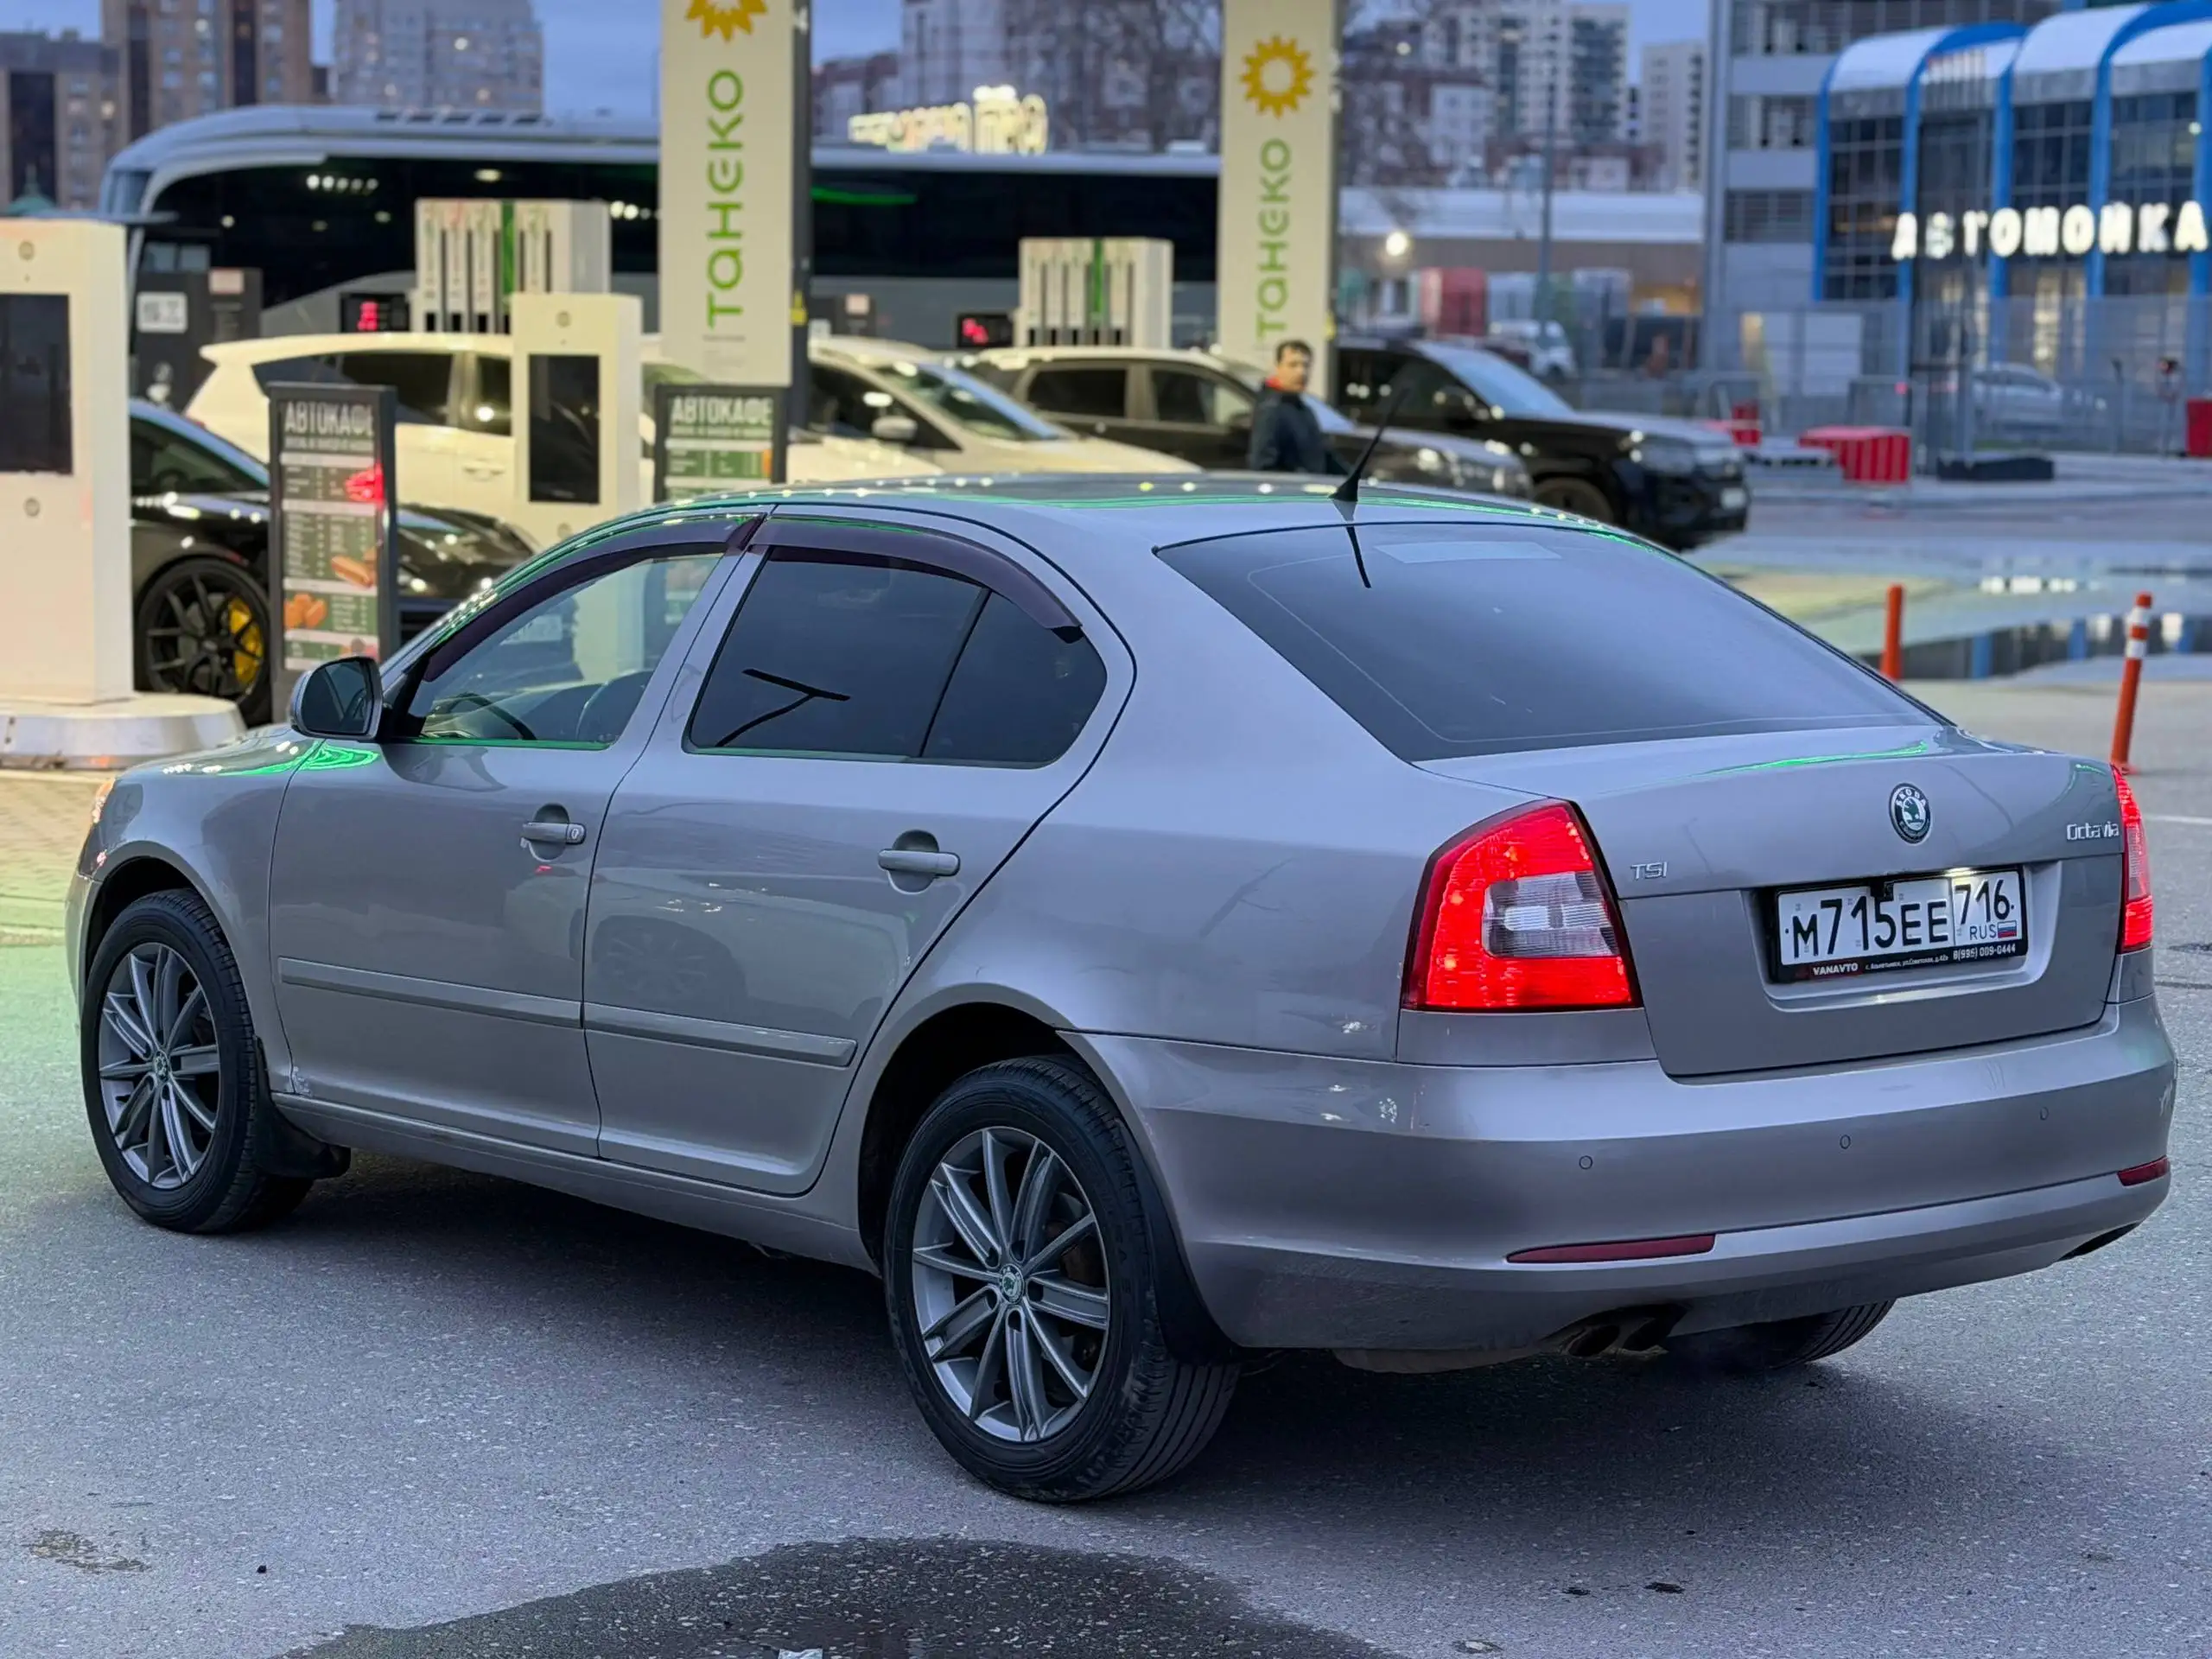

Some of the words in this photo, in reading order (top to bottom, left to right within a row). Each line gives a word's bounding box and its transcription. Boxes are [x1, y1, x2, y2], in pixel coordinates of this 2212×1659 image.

[671, 397, 772, 426] АВТОКАФЕ
[2067, 821, 2120, 840] Octavia
[1631, 861, 1668, 880] TSI
[1955, 880, 2011, 925] 716
[1969, 924, 1997, 941] RUS
[1813, 963, 1859, 975] VANAVTO
